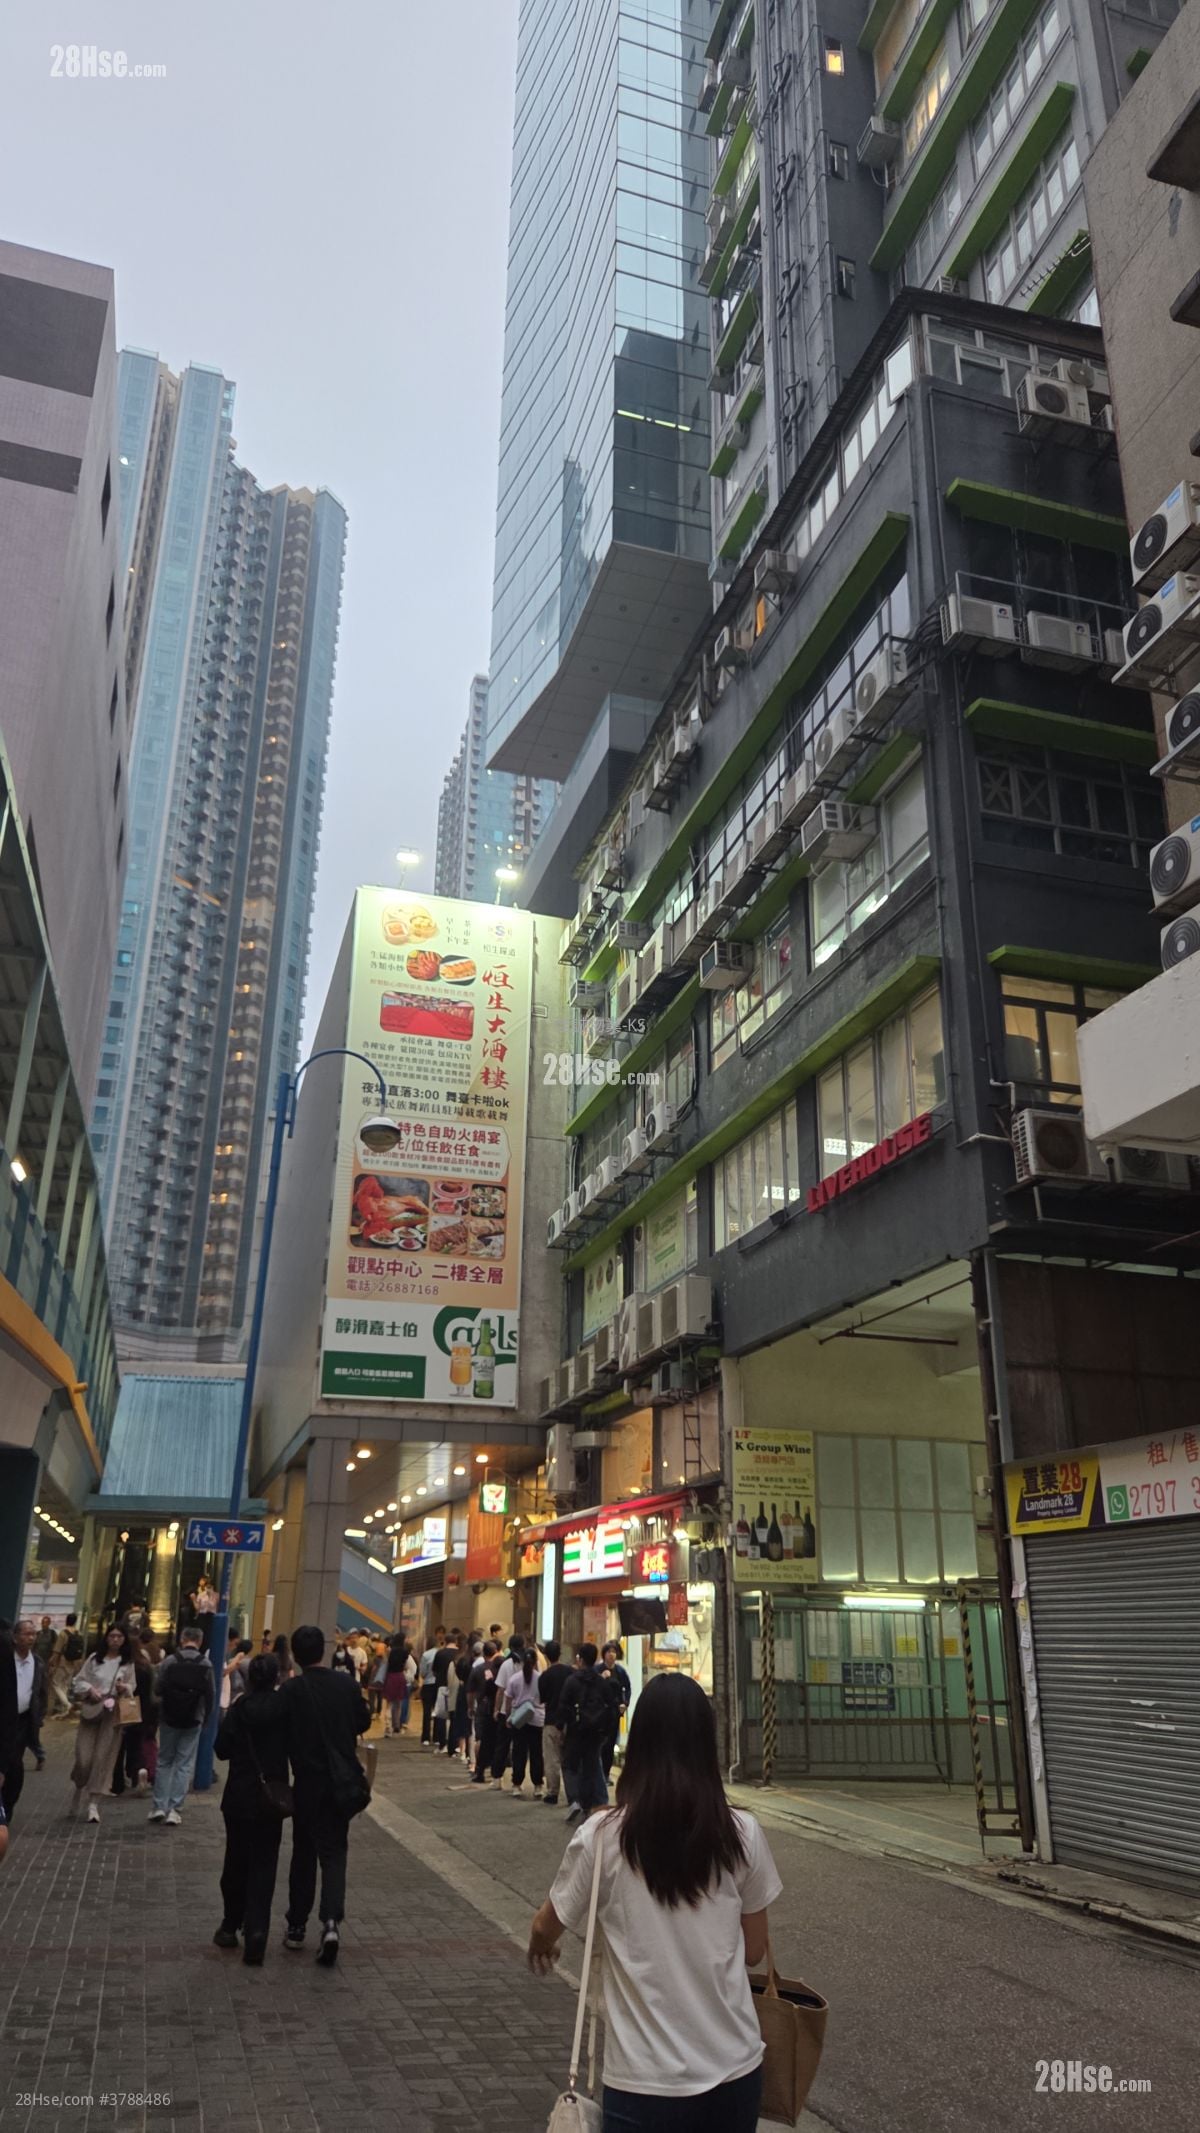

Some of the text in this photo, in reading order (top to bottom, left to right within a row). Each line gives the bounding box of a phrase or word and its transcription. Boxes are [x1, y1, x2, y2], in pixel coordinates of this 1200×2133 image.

[480, 963, 514, 1091] 恒生大酒樓
[807, 1112, 934, 1214] LIVEHOUSE
[347, 1255, 504, 1285] 觀點中心 二樓全層
[378, 1283, 439, 1296] 26887168
[335, 1317, 418, 1338] 醇滑嘉士伯
[735, 1430, 752, 1439] 1/F
[735, 1441, 812, 1454] K Group Wine
[1023, 1462, 1082, 1495] 置業28
[1025, 1494, 1074, 1512] Landmark 28
[1129, 1480, 1176, 1517] 2797
